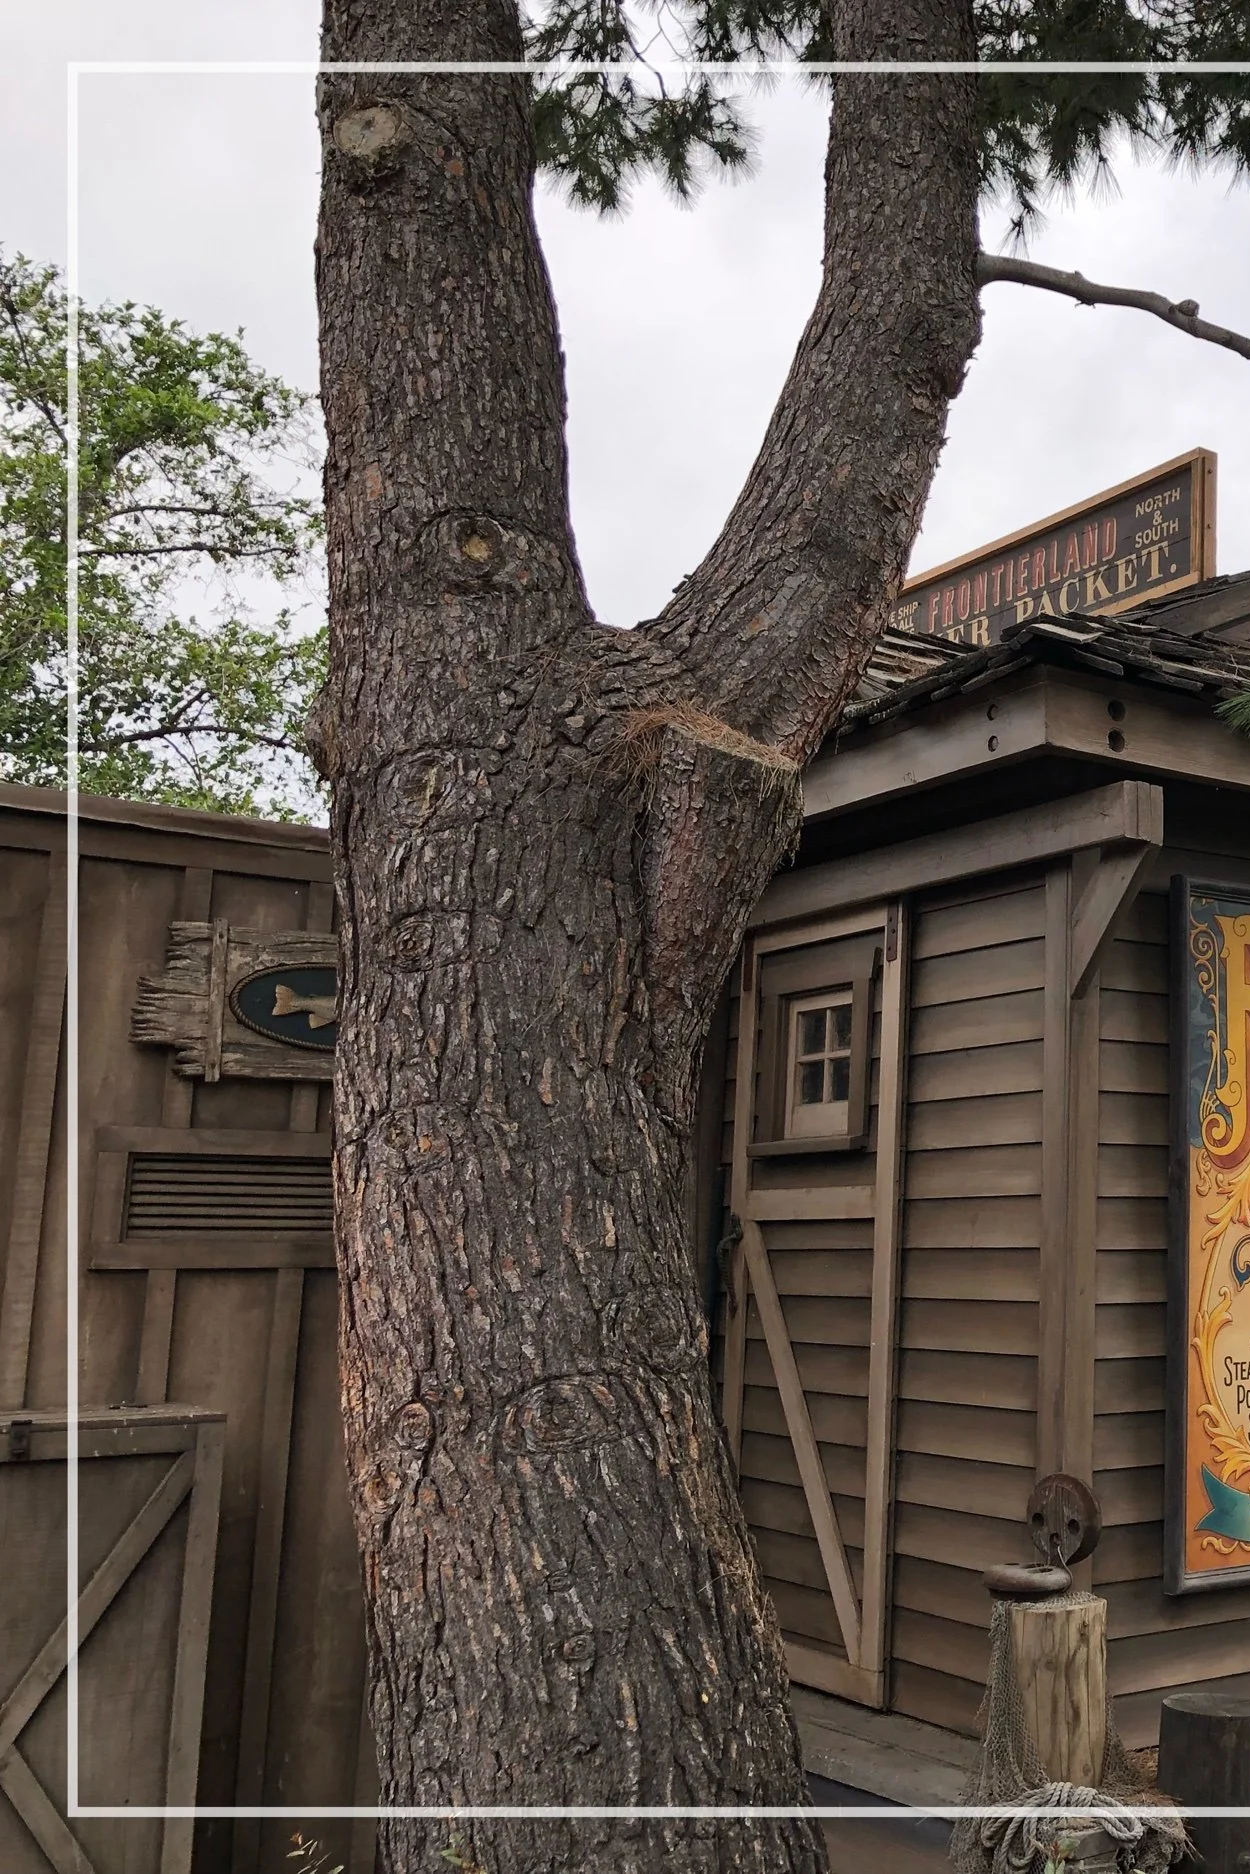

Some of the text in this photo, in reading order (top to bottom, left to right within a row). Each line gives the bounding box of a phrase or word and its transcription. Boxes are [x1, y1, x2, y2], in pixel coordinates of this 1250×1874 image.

[1135, 487, 1181, 519] NORTH
[1152, 510, 1163, 525] &
[1135, 518, 1179, 549] SOUTH
[928, 517, 1118, 634] FRONTIERLAND
[1013, 540, 1178, 624] PACKET.
[898, 601, 919, 620] SHIP
[899, 615, 914, 631] ALL
